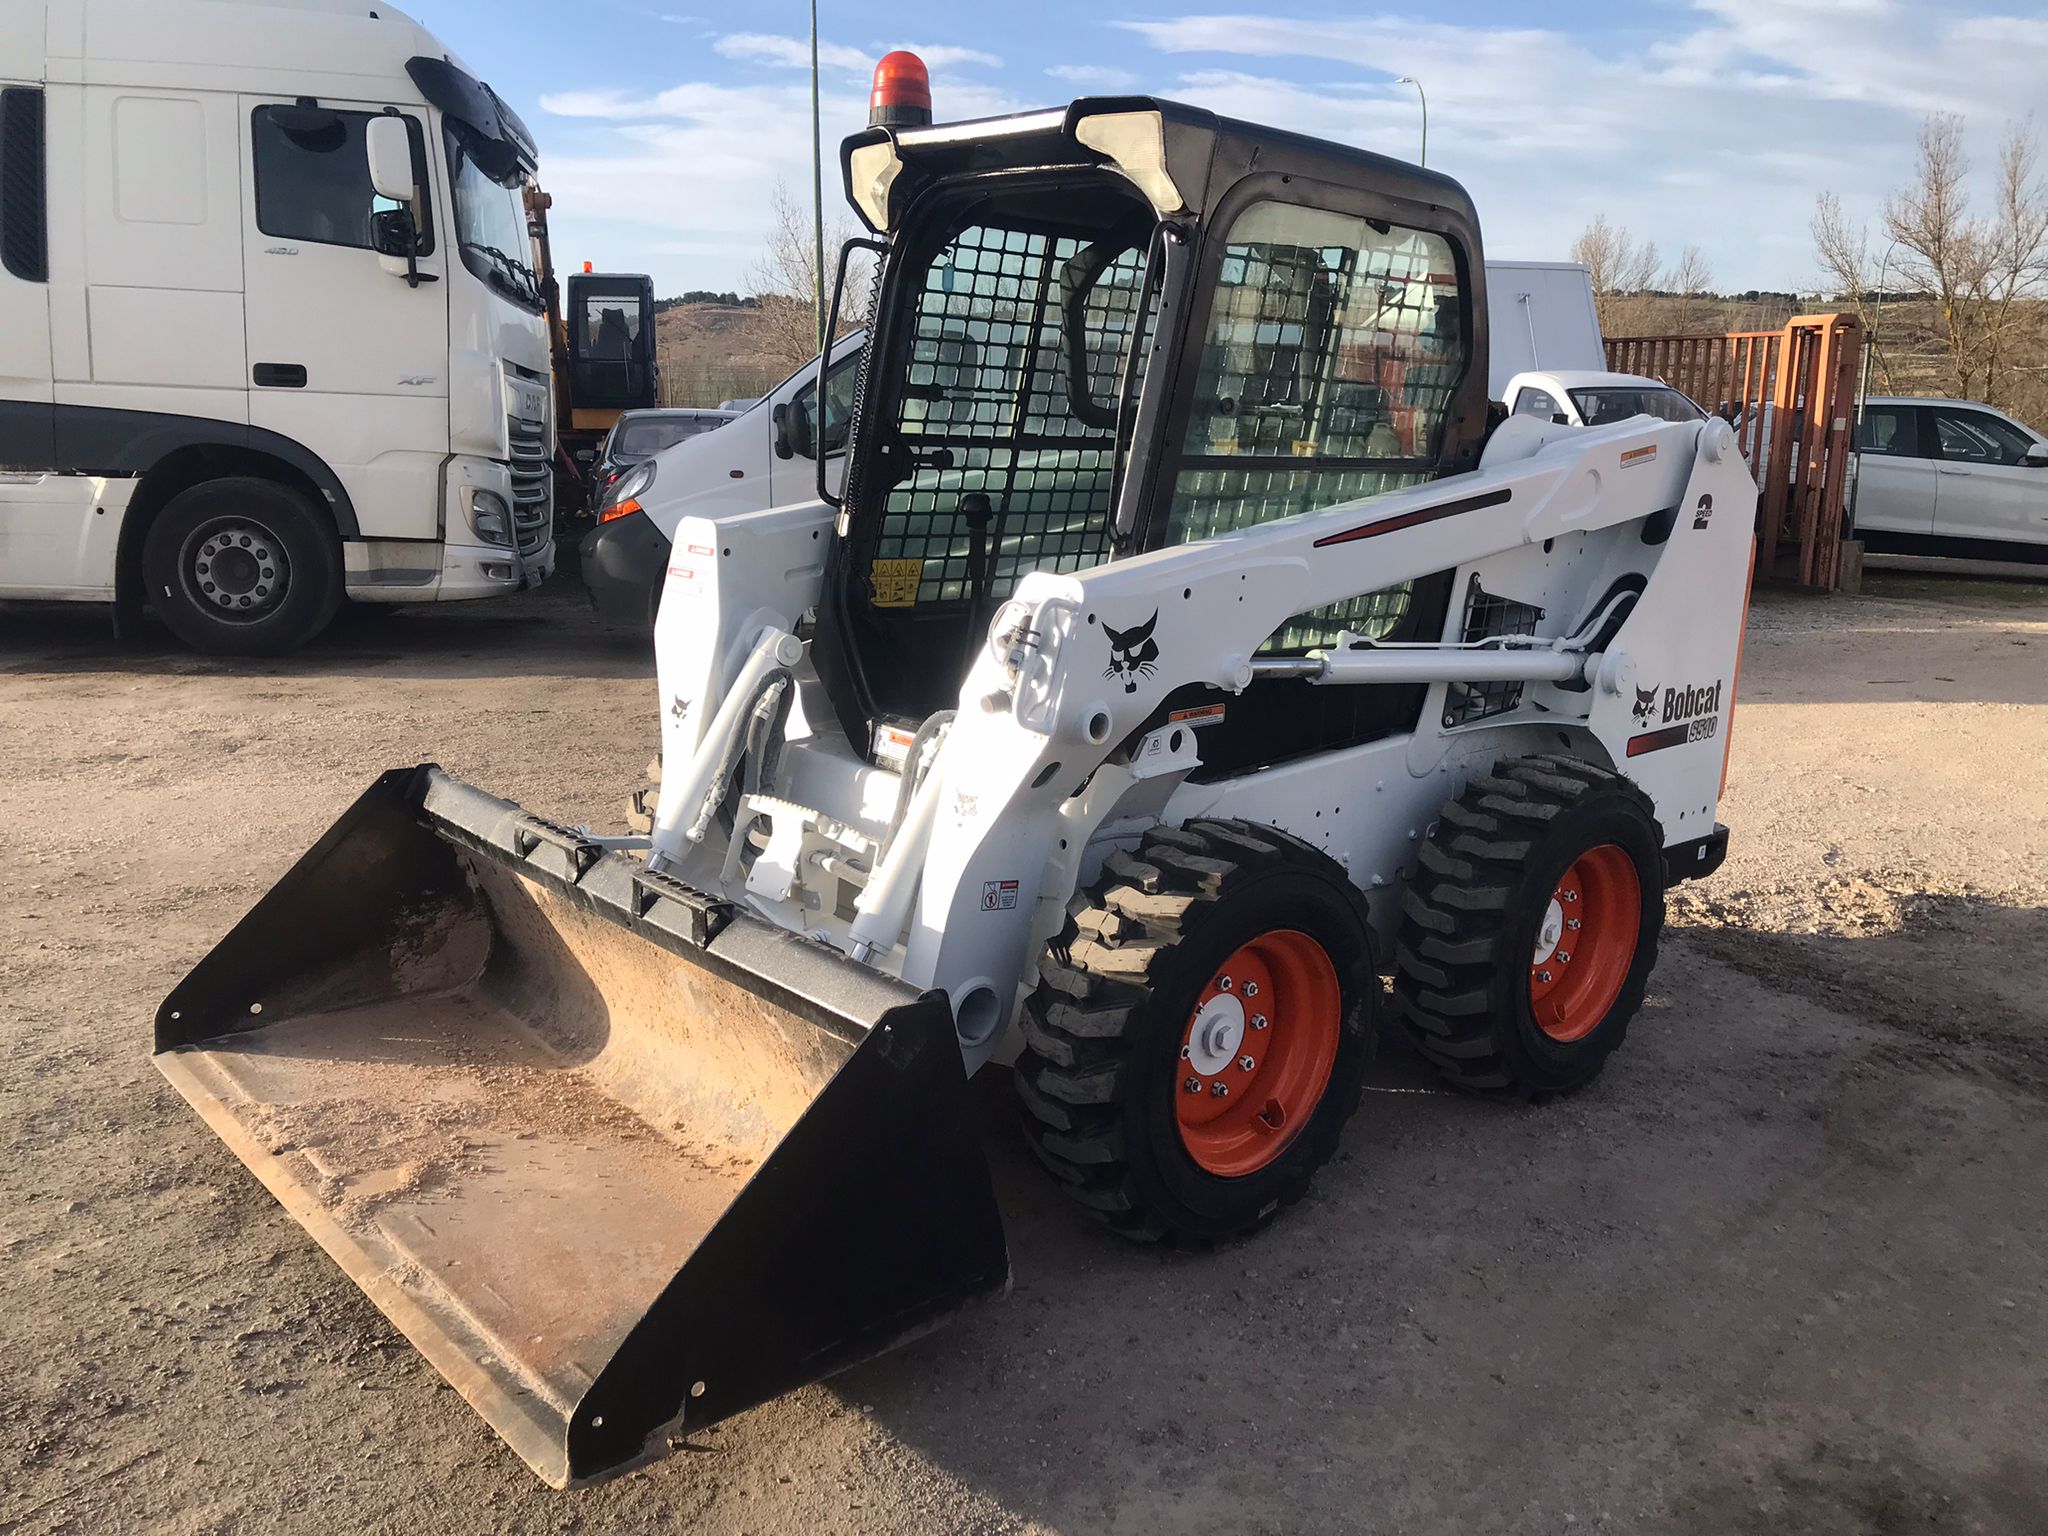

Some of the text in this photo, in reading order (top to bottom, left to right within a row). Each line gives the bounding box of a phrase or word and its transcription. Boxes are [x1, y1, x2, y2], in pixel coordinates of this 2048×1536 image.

[1693, 493, 1713, 530] 2
[1695, 509, 1713, 518] SPEED
[1662, 679, 1722, 724] Bobcat
[1688, 716, 1718, 743] S510
